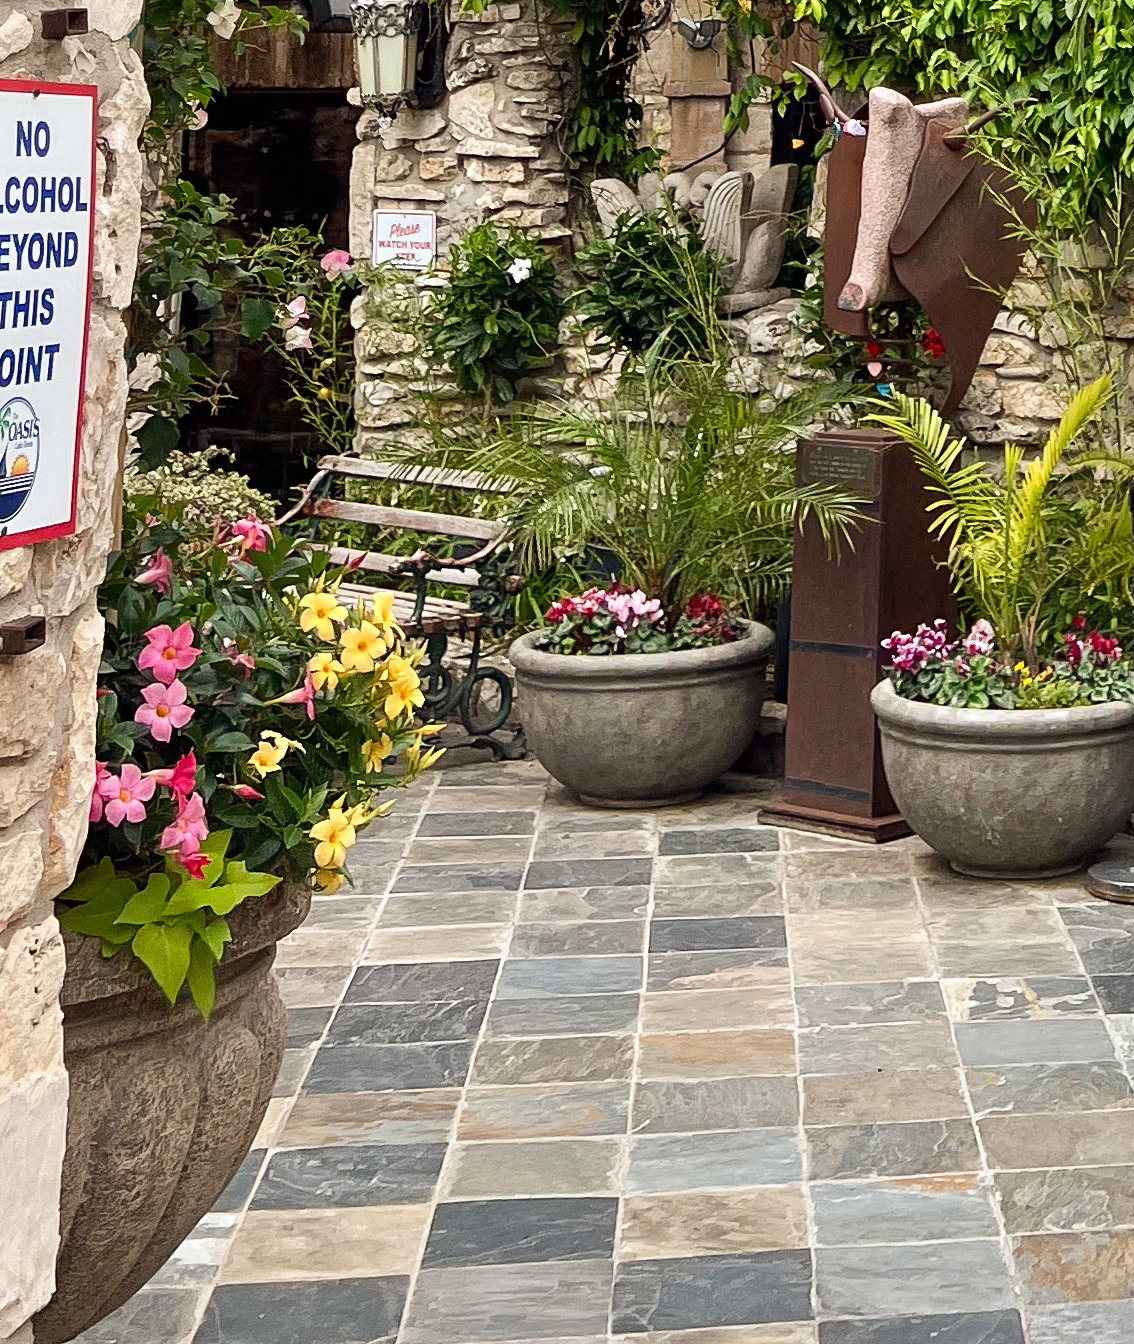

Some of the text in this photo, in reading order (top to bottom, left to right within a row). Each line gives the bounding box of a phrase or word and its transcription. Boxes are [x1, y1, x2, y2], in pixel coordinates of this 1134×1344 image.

[16, 121, 51, 157] NO
[0, 176, 88, 213] COHOL
[0, 232, 79, 271] EYOND
[379, 241, 431, 249] WATCH YOUR
[0, 288, 55, 329] THIS
[0, 343, 60, 388] OINT
[8, 418, 40, 441] OASIS
